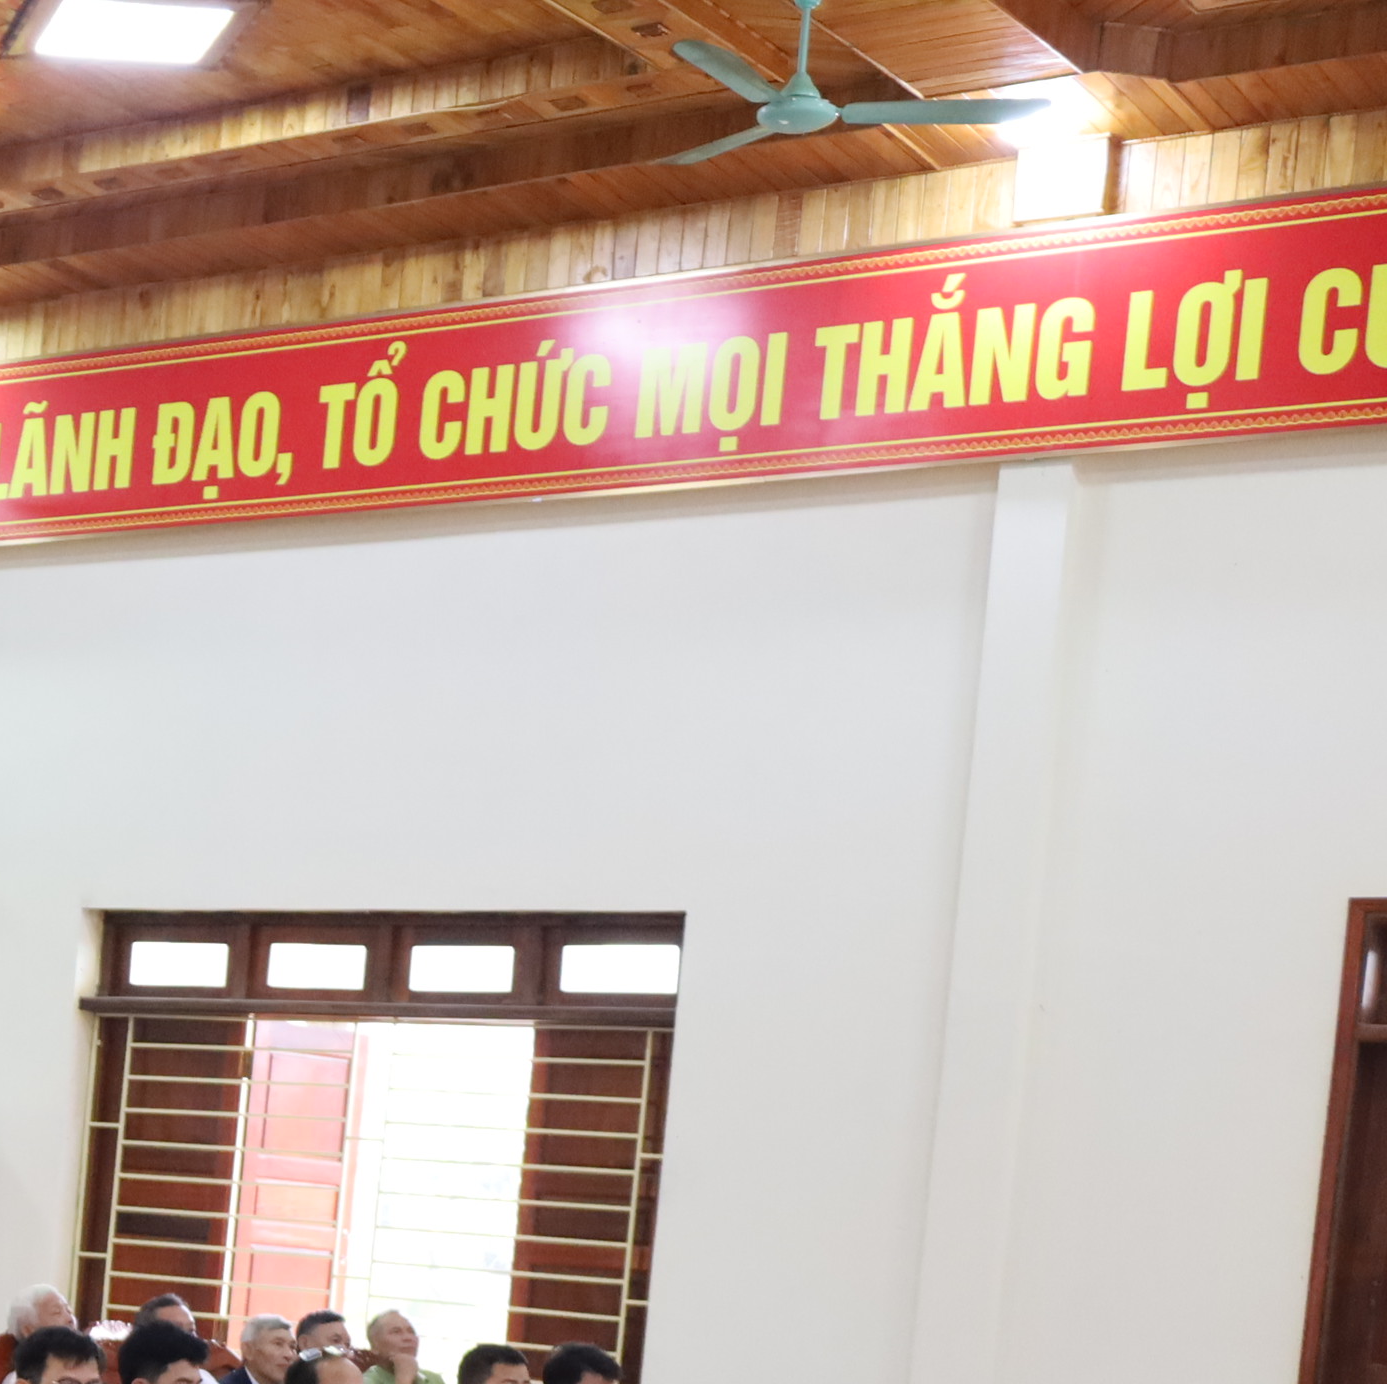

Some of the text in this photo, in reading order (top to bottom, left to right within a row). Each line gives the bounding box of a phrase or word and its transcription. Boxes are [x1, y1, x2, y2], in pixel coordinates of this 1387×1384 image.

[151, 391, 294, 500] ĐẠO,
[319, 340, 408, 470] TỔ
[419, 340, 609, 460] CHỨC
[634, 332, 789, 452] MỌI
[815, 274, 1095, 421] THẮNG
[1122, 269, 1269, 410] LỢI
